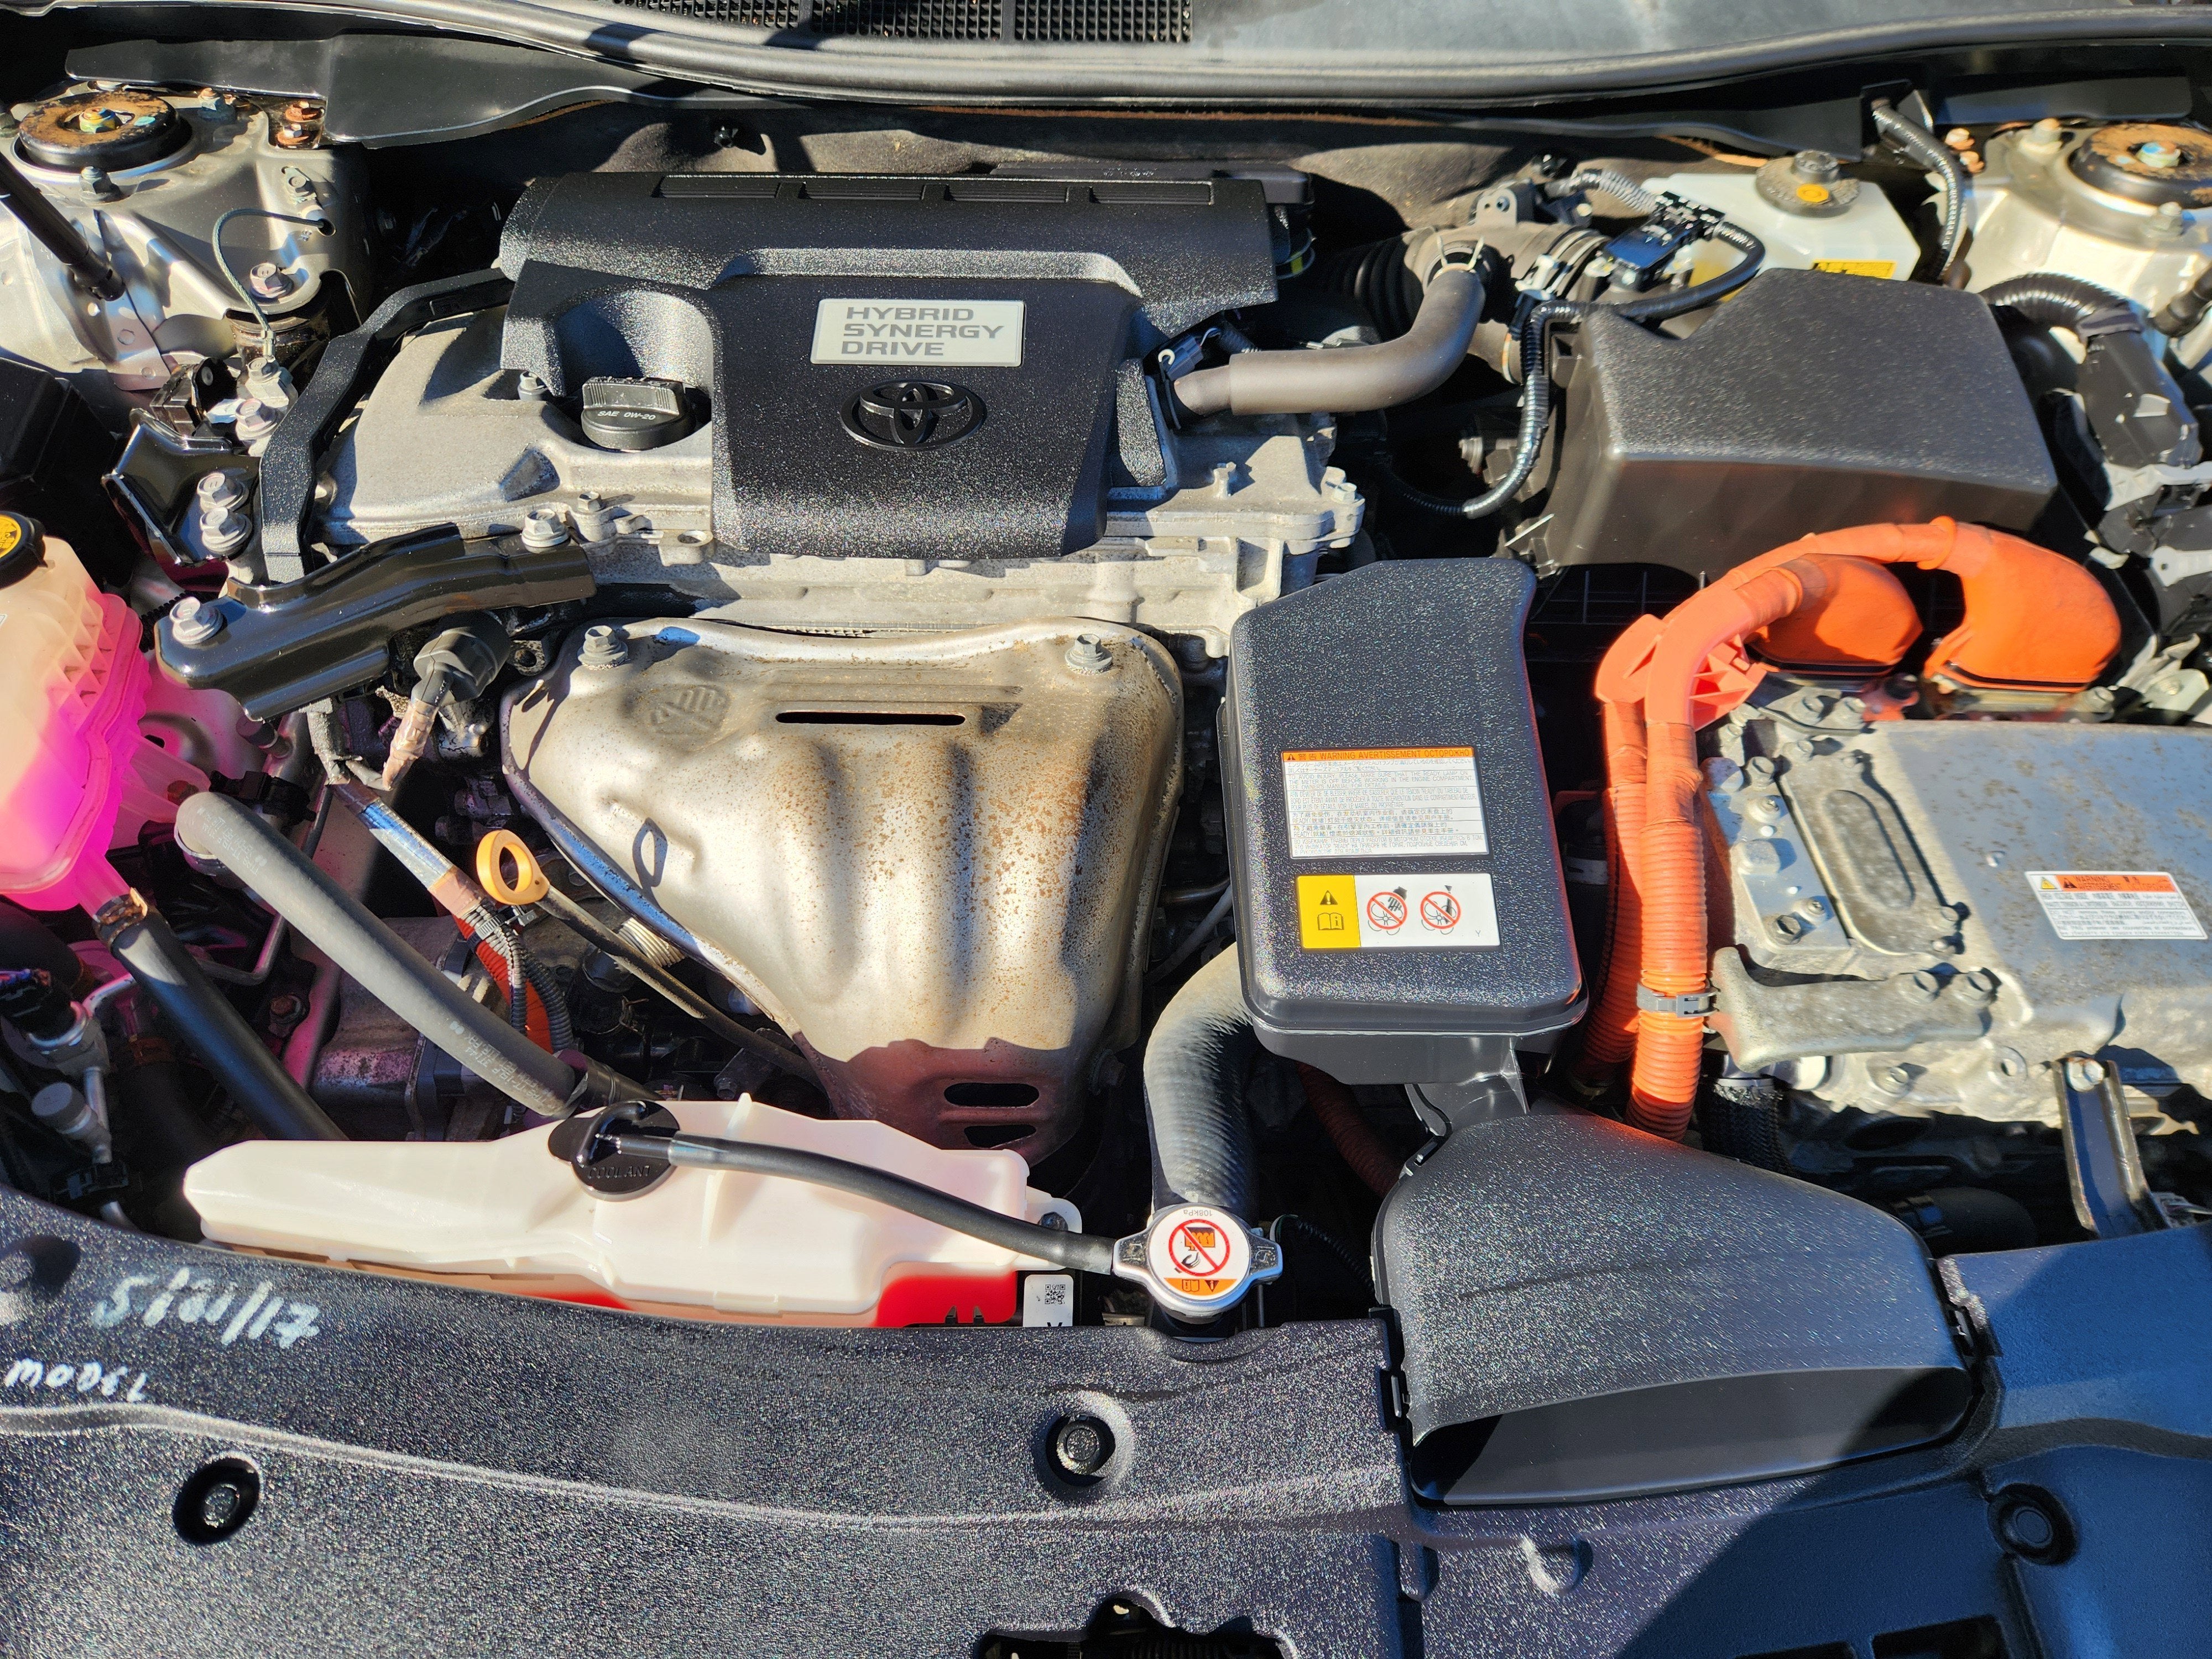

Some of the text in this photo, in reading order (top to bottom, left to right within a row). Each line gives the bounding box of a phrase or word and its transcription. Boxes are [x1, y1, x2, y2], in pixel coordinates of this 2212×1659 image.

[847, 307, 974, 321] HYBRID
[843, 324, 1003, 338] SYNERGY
[841, 341, 945, 356] DRIVE
[624, 411, 656, 420] 0W-20
[1319, 752, 1355, 760] WARNING
[1358, 750, 1422, 759] AVERTISSEMENT
[588, 1165, 651, 1178] COOLANT
